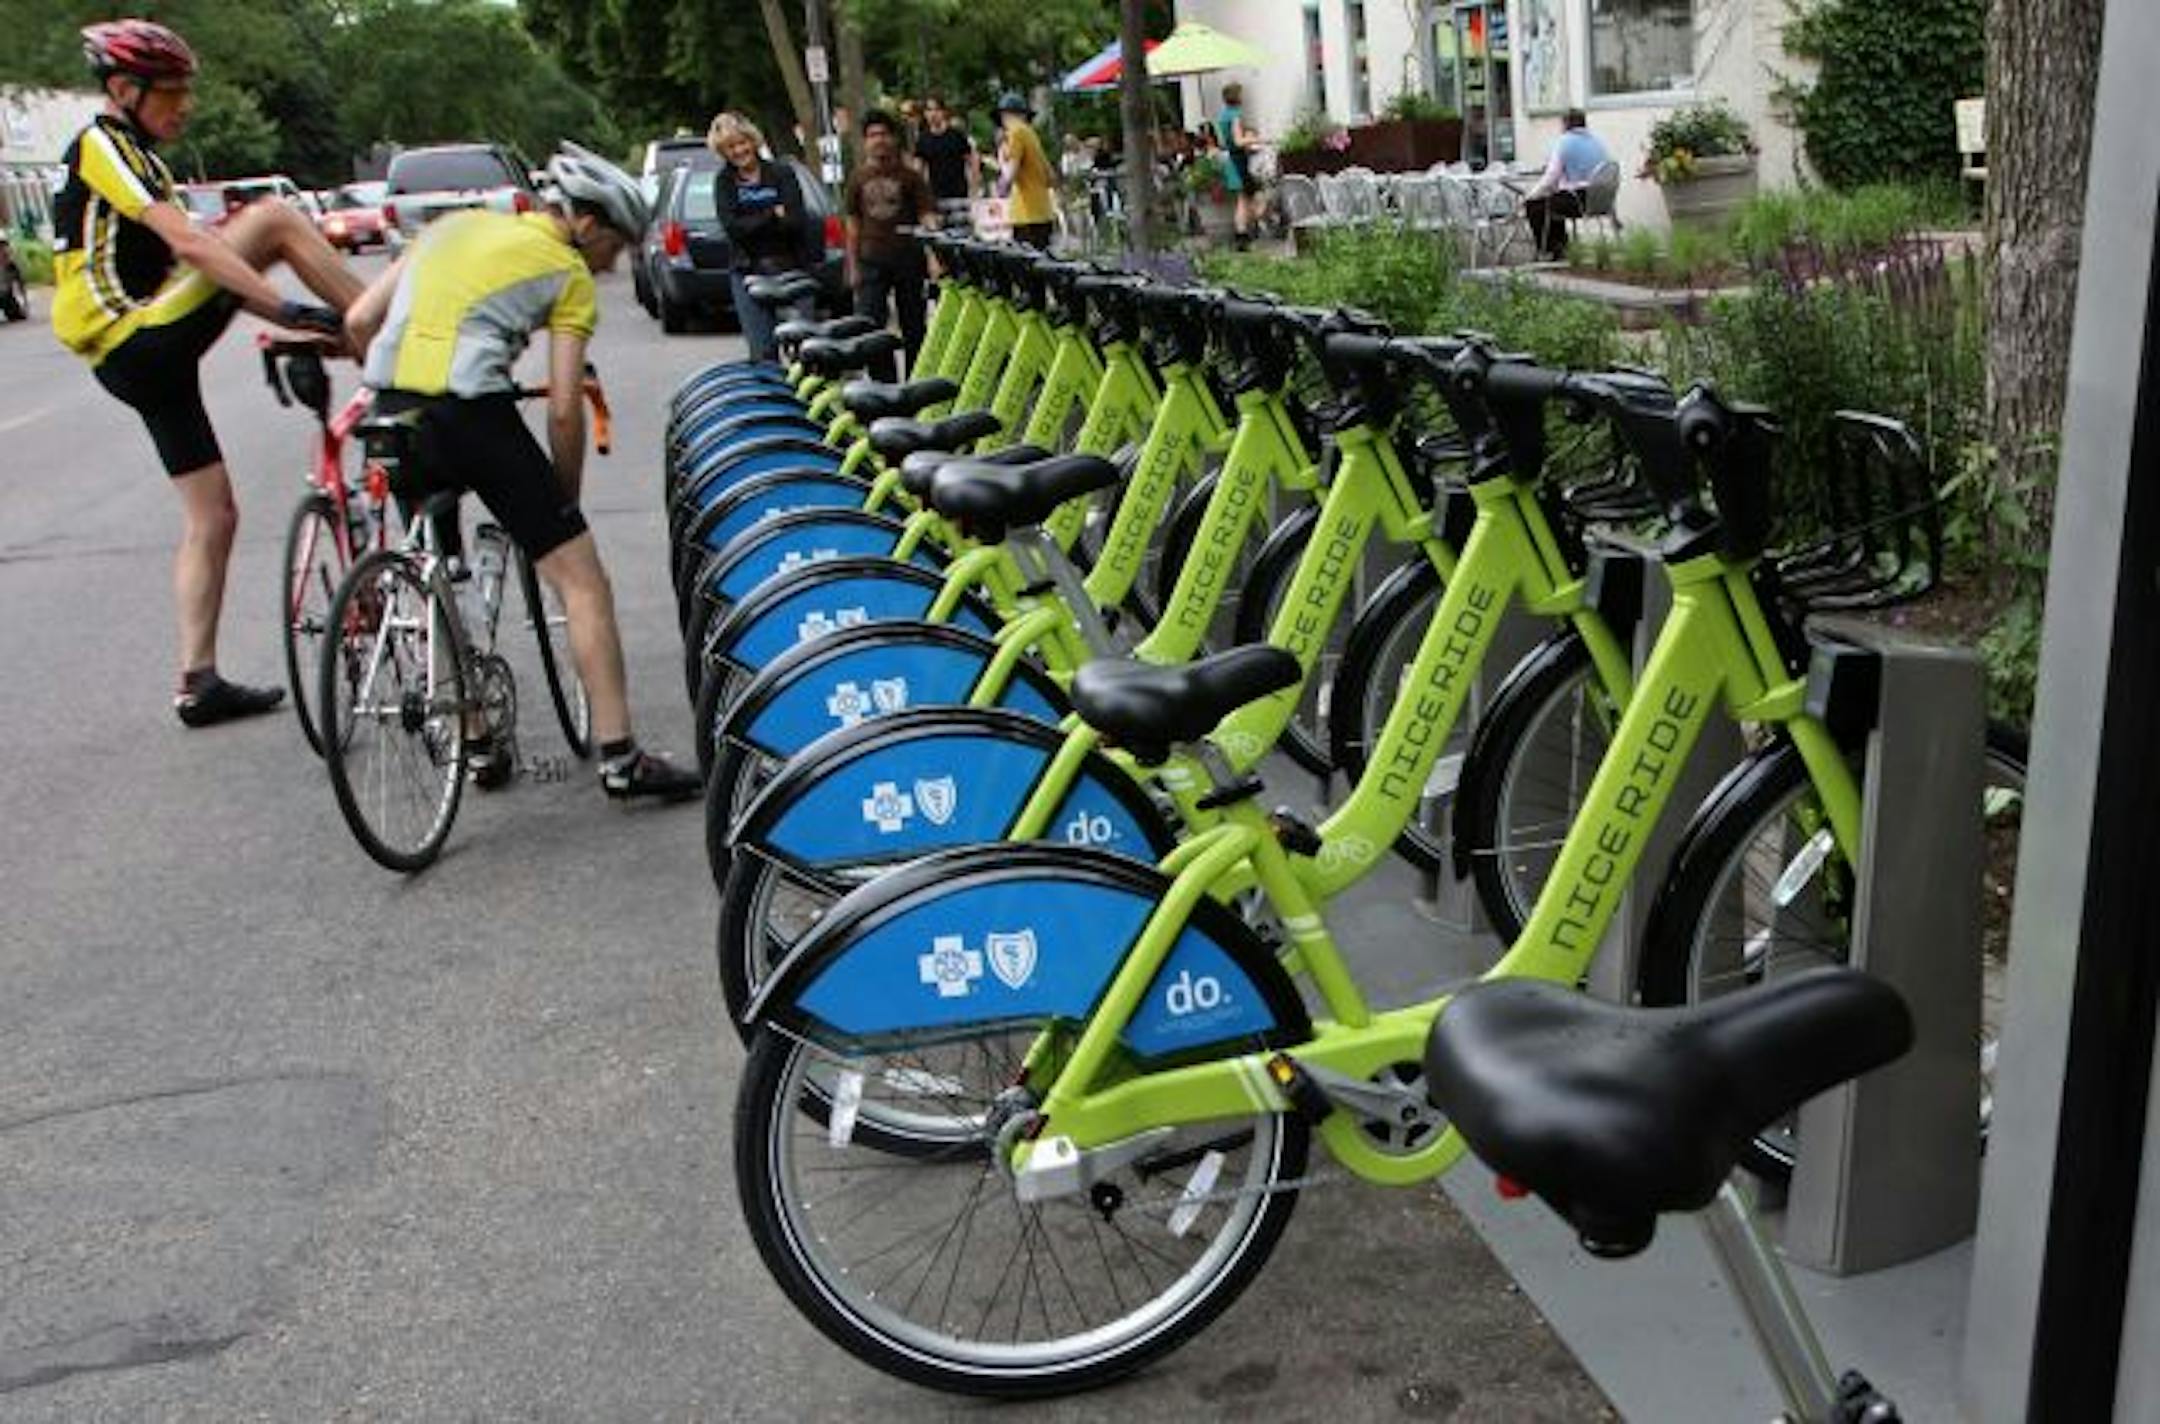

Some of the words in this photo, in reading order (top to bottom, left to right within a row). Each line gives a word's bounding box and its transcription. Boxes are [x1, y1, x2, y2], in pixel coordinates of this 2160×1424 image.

[1140, 431, 1182, 499] RIDE
[1178, 550, 1222, 628] NICE
[1211, 466, 1257, 546] RIDE
[1286, 610, 1319, 655] CE
[1306, 514, 1361, 608] RIDE
[1381, 694, 1449, 802] NICE
[1432, 581, 1498, 693] RIDE
[1550, 828, 1630, 951] NICE
[1620, 684, 1698, 821] RIDE
[1166, 969, 1232, 1016] do.
